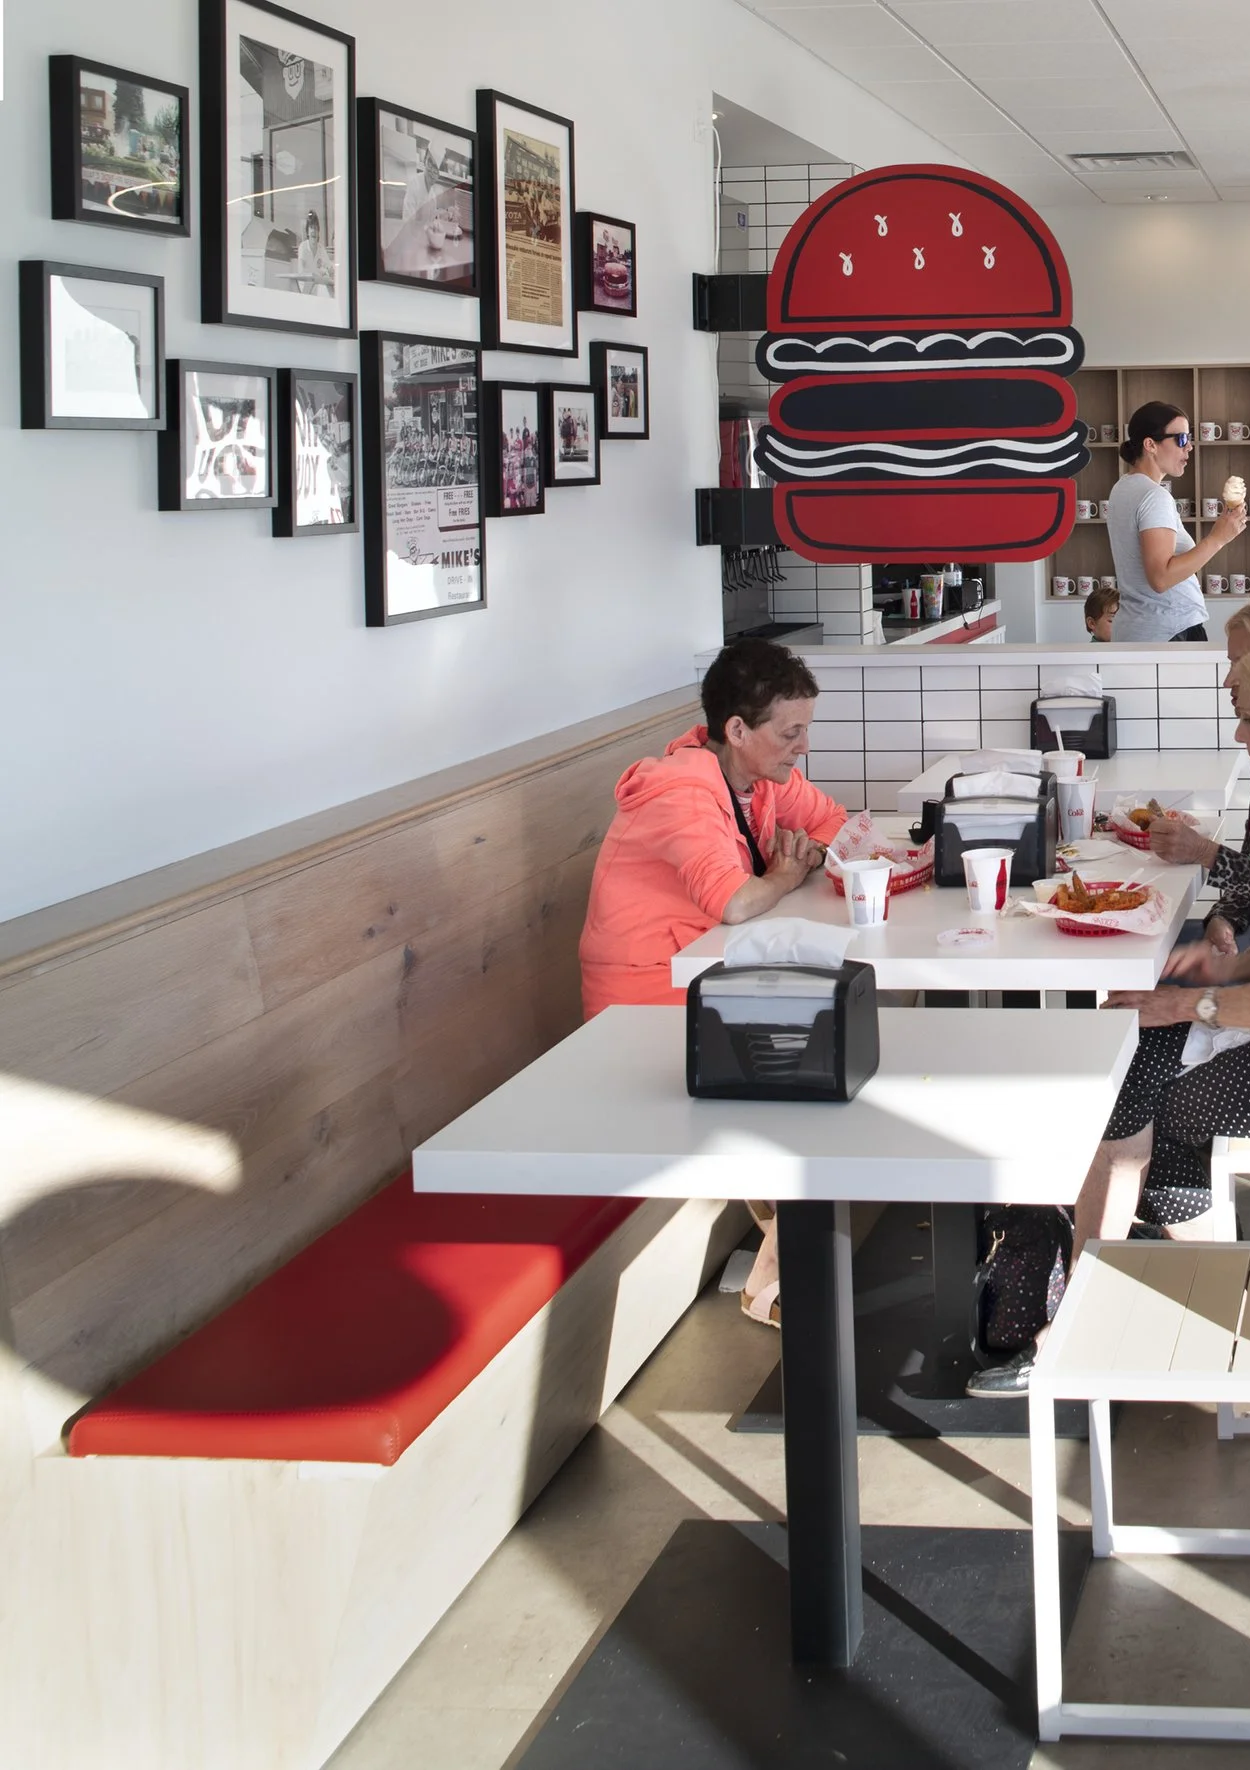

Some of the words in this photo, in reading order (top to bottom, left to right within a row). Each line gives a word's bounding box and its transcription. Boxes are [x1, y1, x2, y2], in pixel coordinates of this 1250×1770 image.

[441, 548, 480, 569] MIKE'S
[1067, 808, 1085, 817] Coke
[852, 894, 866, 902] Coke
